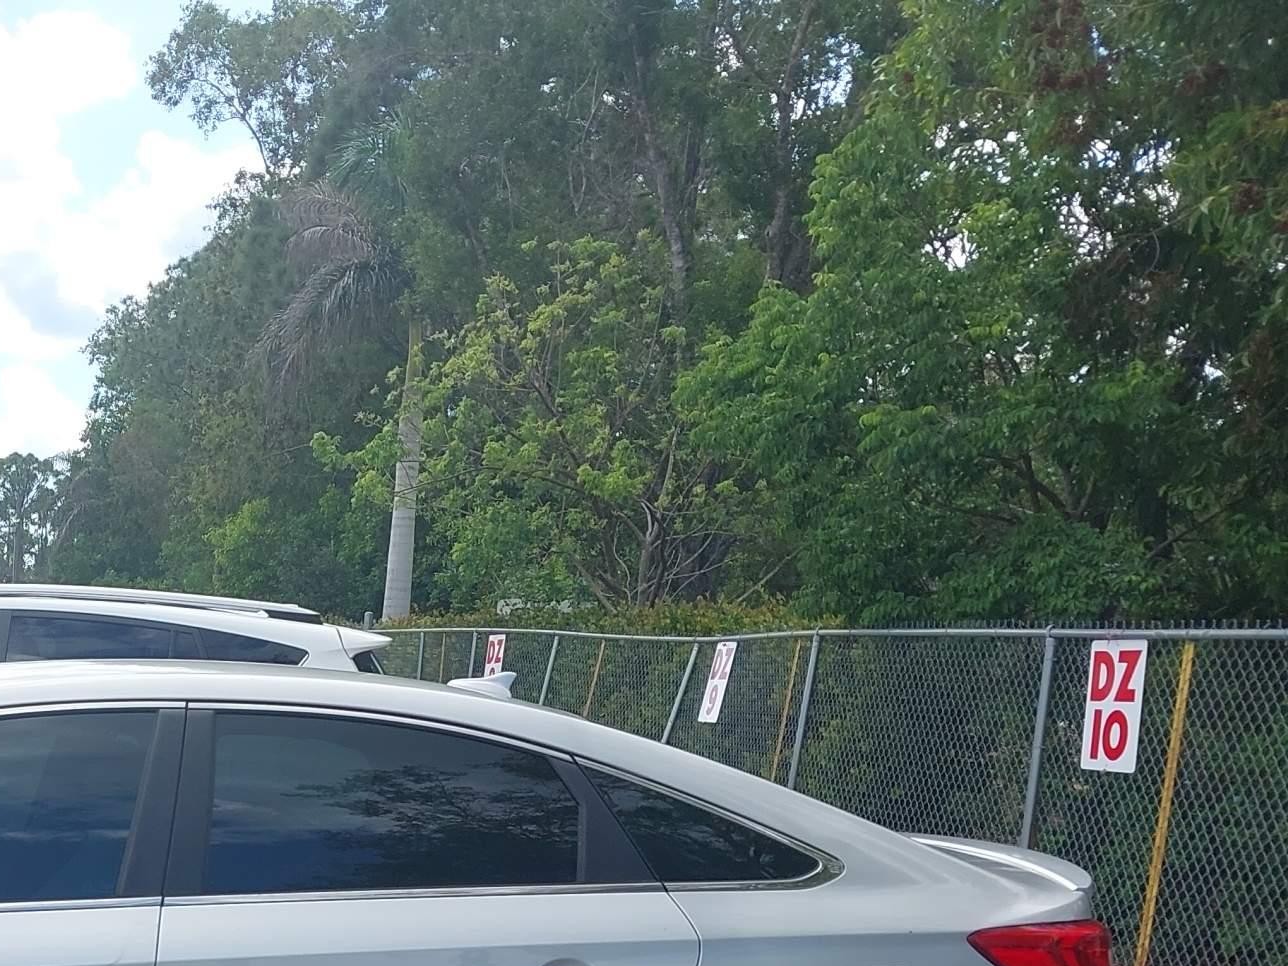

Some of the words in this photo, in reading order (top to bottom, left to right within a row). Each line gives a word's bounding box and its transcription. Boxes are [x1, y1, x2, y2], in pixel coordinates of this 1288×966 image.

[486, 639, 505, 665] DZ
[711, 647, 734, 680] DZ
[1090, 650, 1143, 702] DZ
[705, 684, 719, 716] 9
[1089, 709, 1129, 761] 10
